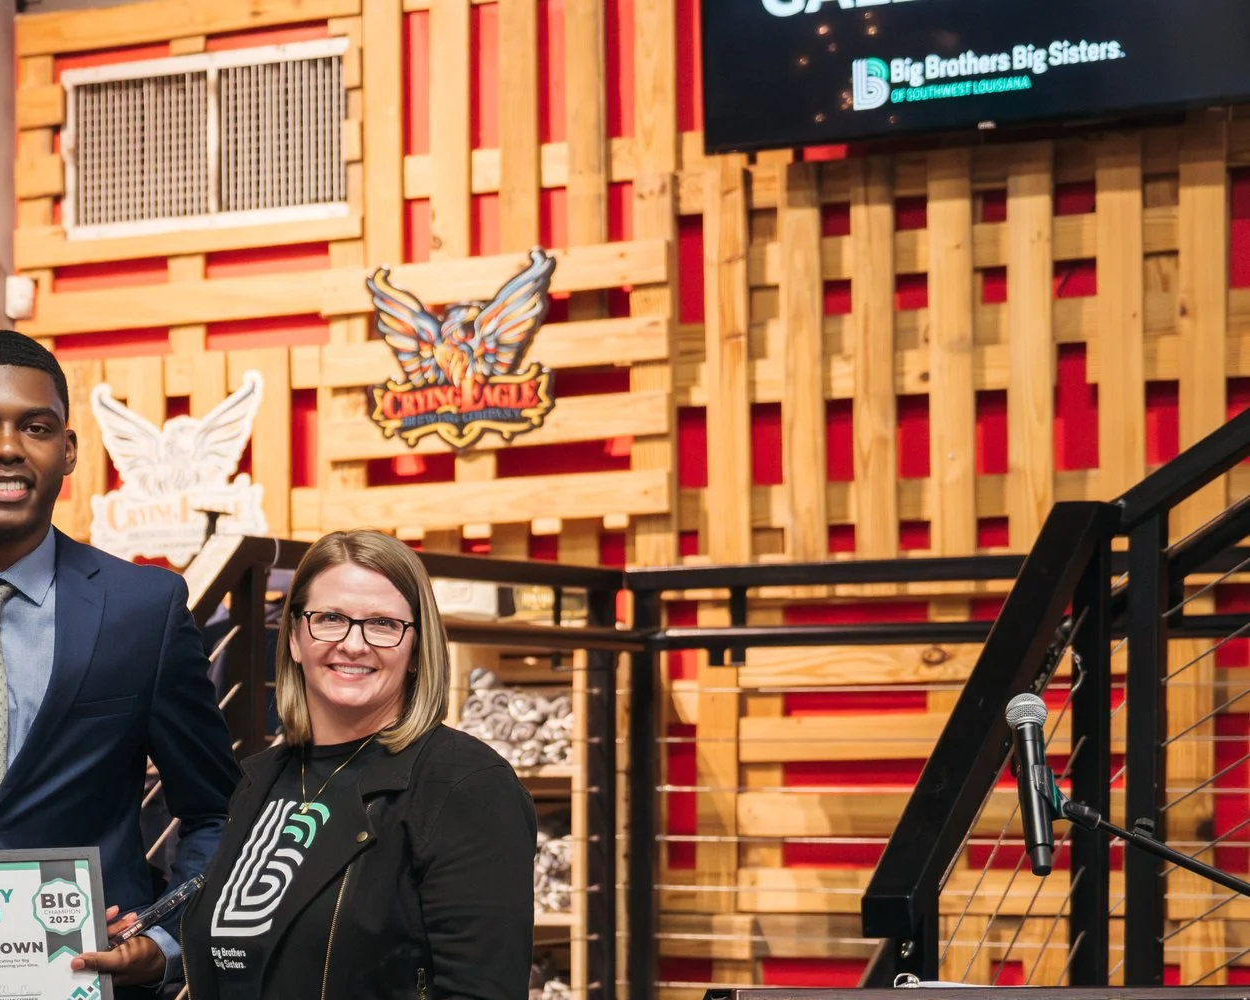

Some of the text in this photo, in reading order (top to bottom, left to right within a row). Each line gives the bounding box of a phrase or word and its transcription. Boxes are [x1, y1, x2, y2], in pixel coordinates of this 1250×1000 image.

[890, 56, 924, 88] Big
[925, 49, 1011, 80] Brothers
[1012, 43, 1047, 75] Big
[890, 75, 1032, 104] OF SOUTHWEST LOUISIANA
[382, 375, 539, 420] CRYING EAGLE
[40, 892, 81, 908] BIG
[49, 916, 75, 924] 2025
[211, 947, 246, 959] Big Brothers
